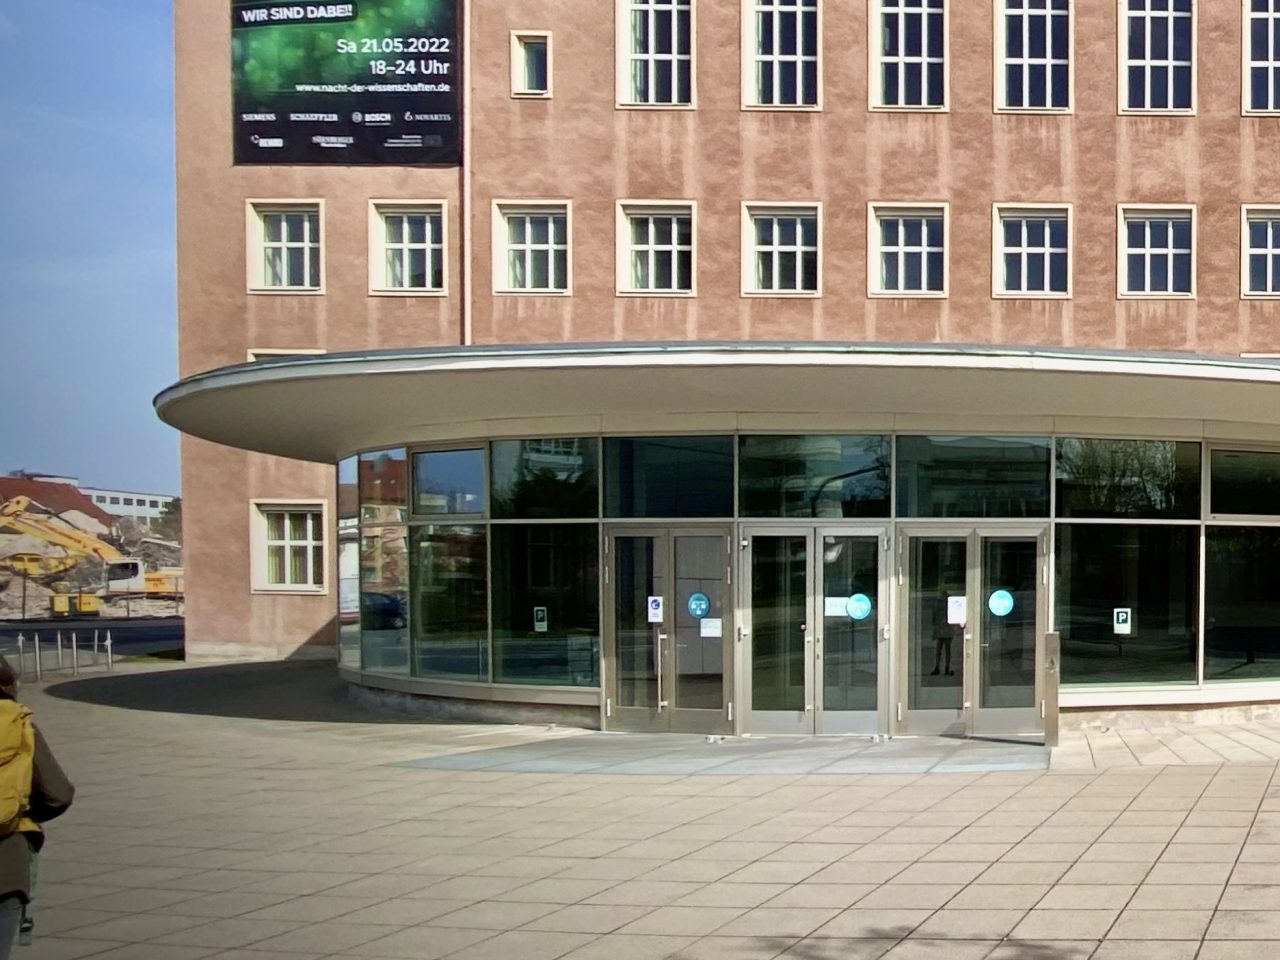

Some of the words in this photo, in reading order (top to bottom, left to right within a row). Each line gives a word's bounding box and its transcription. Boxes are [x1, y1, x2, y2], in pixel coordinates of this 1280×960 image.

[242, 9, 268, 22] WIR
[270, 7, 304, 20] SIND
[307, 4, 353, 19] DABEI!
[336, 39, 357, 53] Sa
[361, 38, 450, 53] 21.05.2022
[421, 60, 450, 74] Uhr
[295, 83, 450, 92] www.nacht-der-wissenschaften.de
